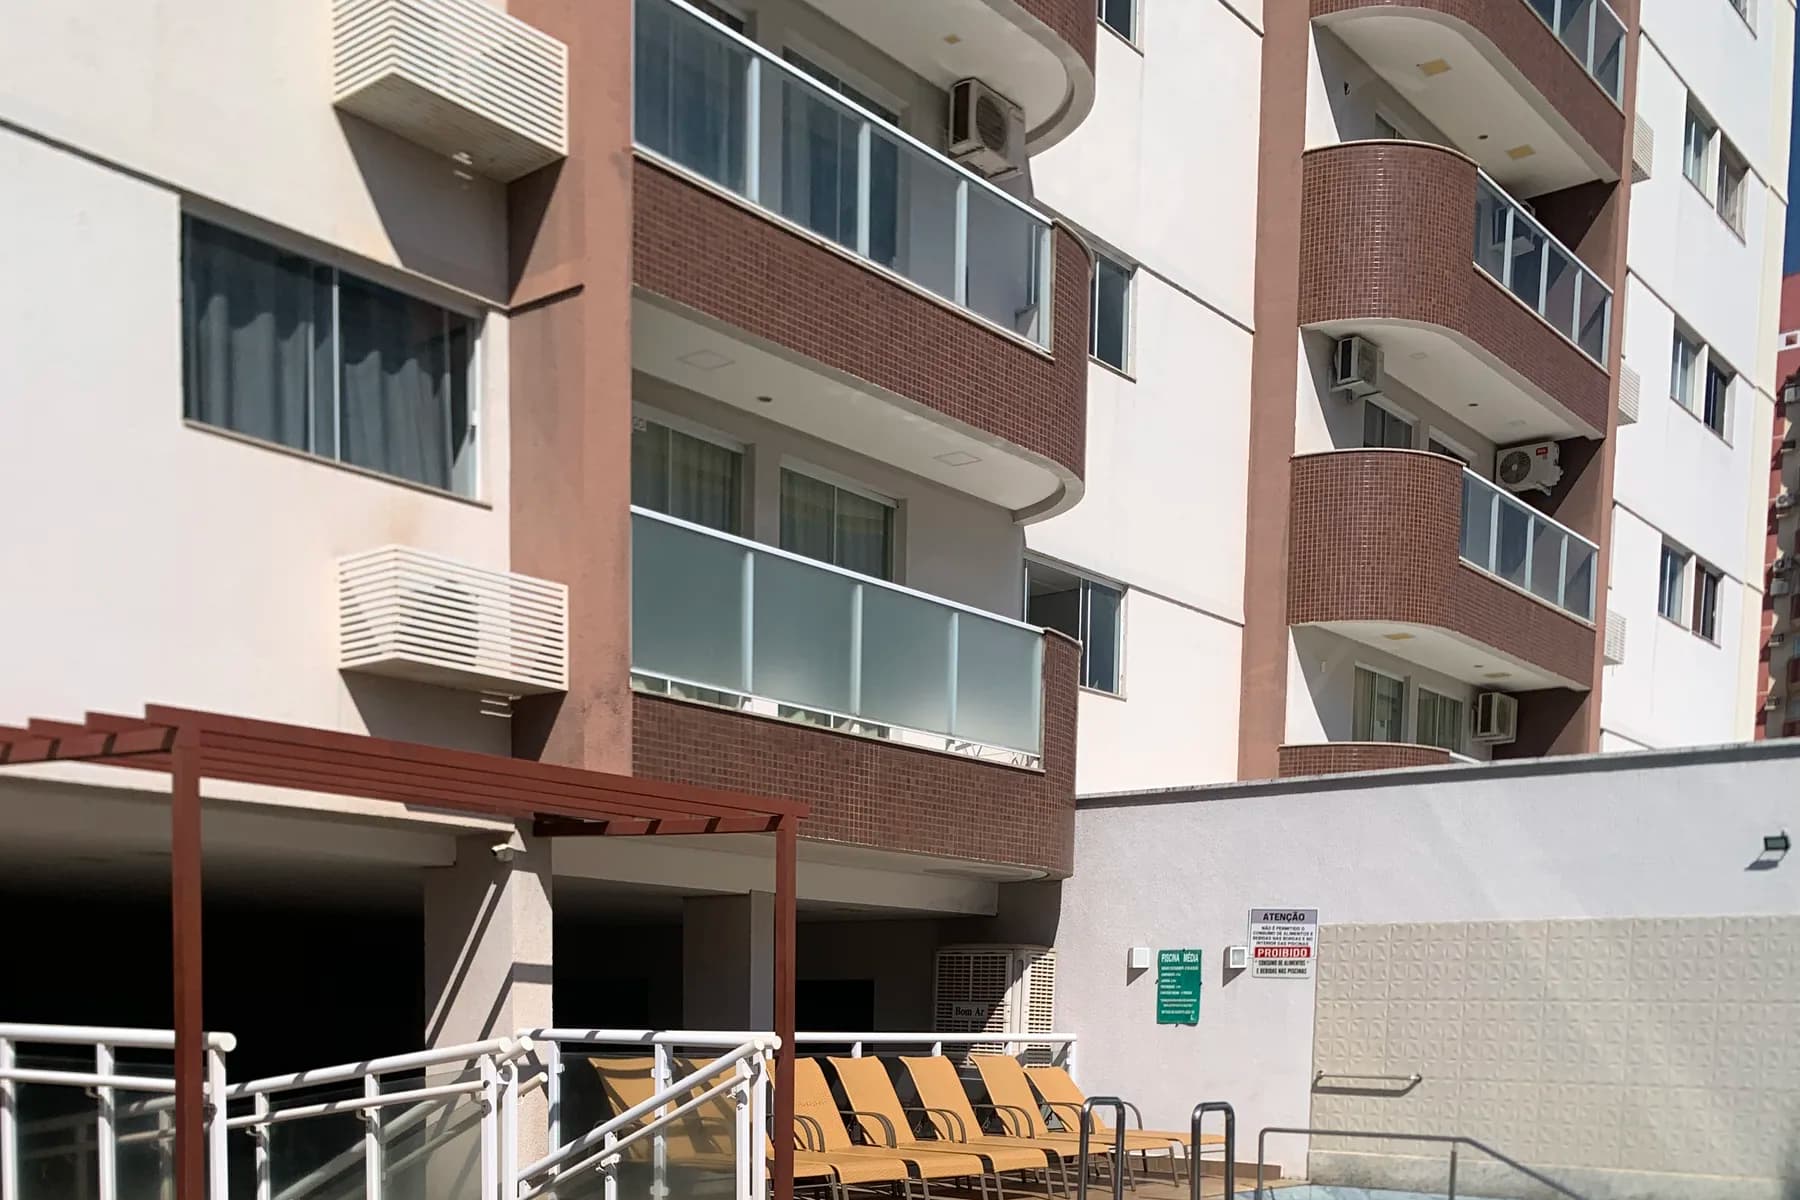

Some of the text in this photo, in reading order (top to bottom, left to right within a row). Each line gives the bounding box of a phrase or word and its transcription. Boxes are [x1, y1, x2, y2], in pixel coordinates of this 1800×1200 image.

[1263, 912, 1305, 922] ATENÇÃO
[1258, 948, 1307, 957] PROIBIDO
[1161, 953, 1180, 962] PISCINA
[955, 1007, 985, 1016] Bom Ar
